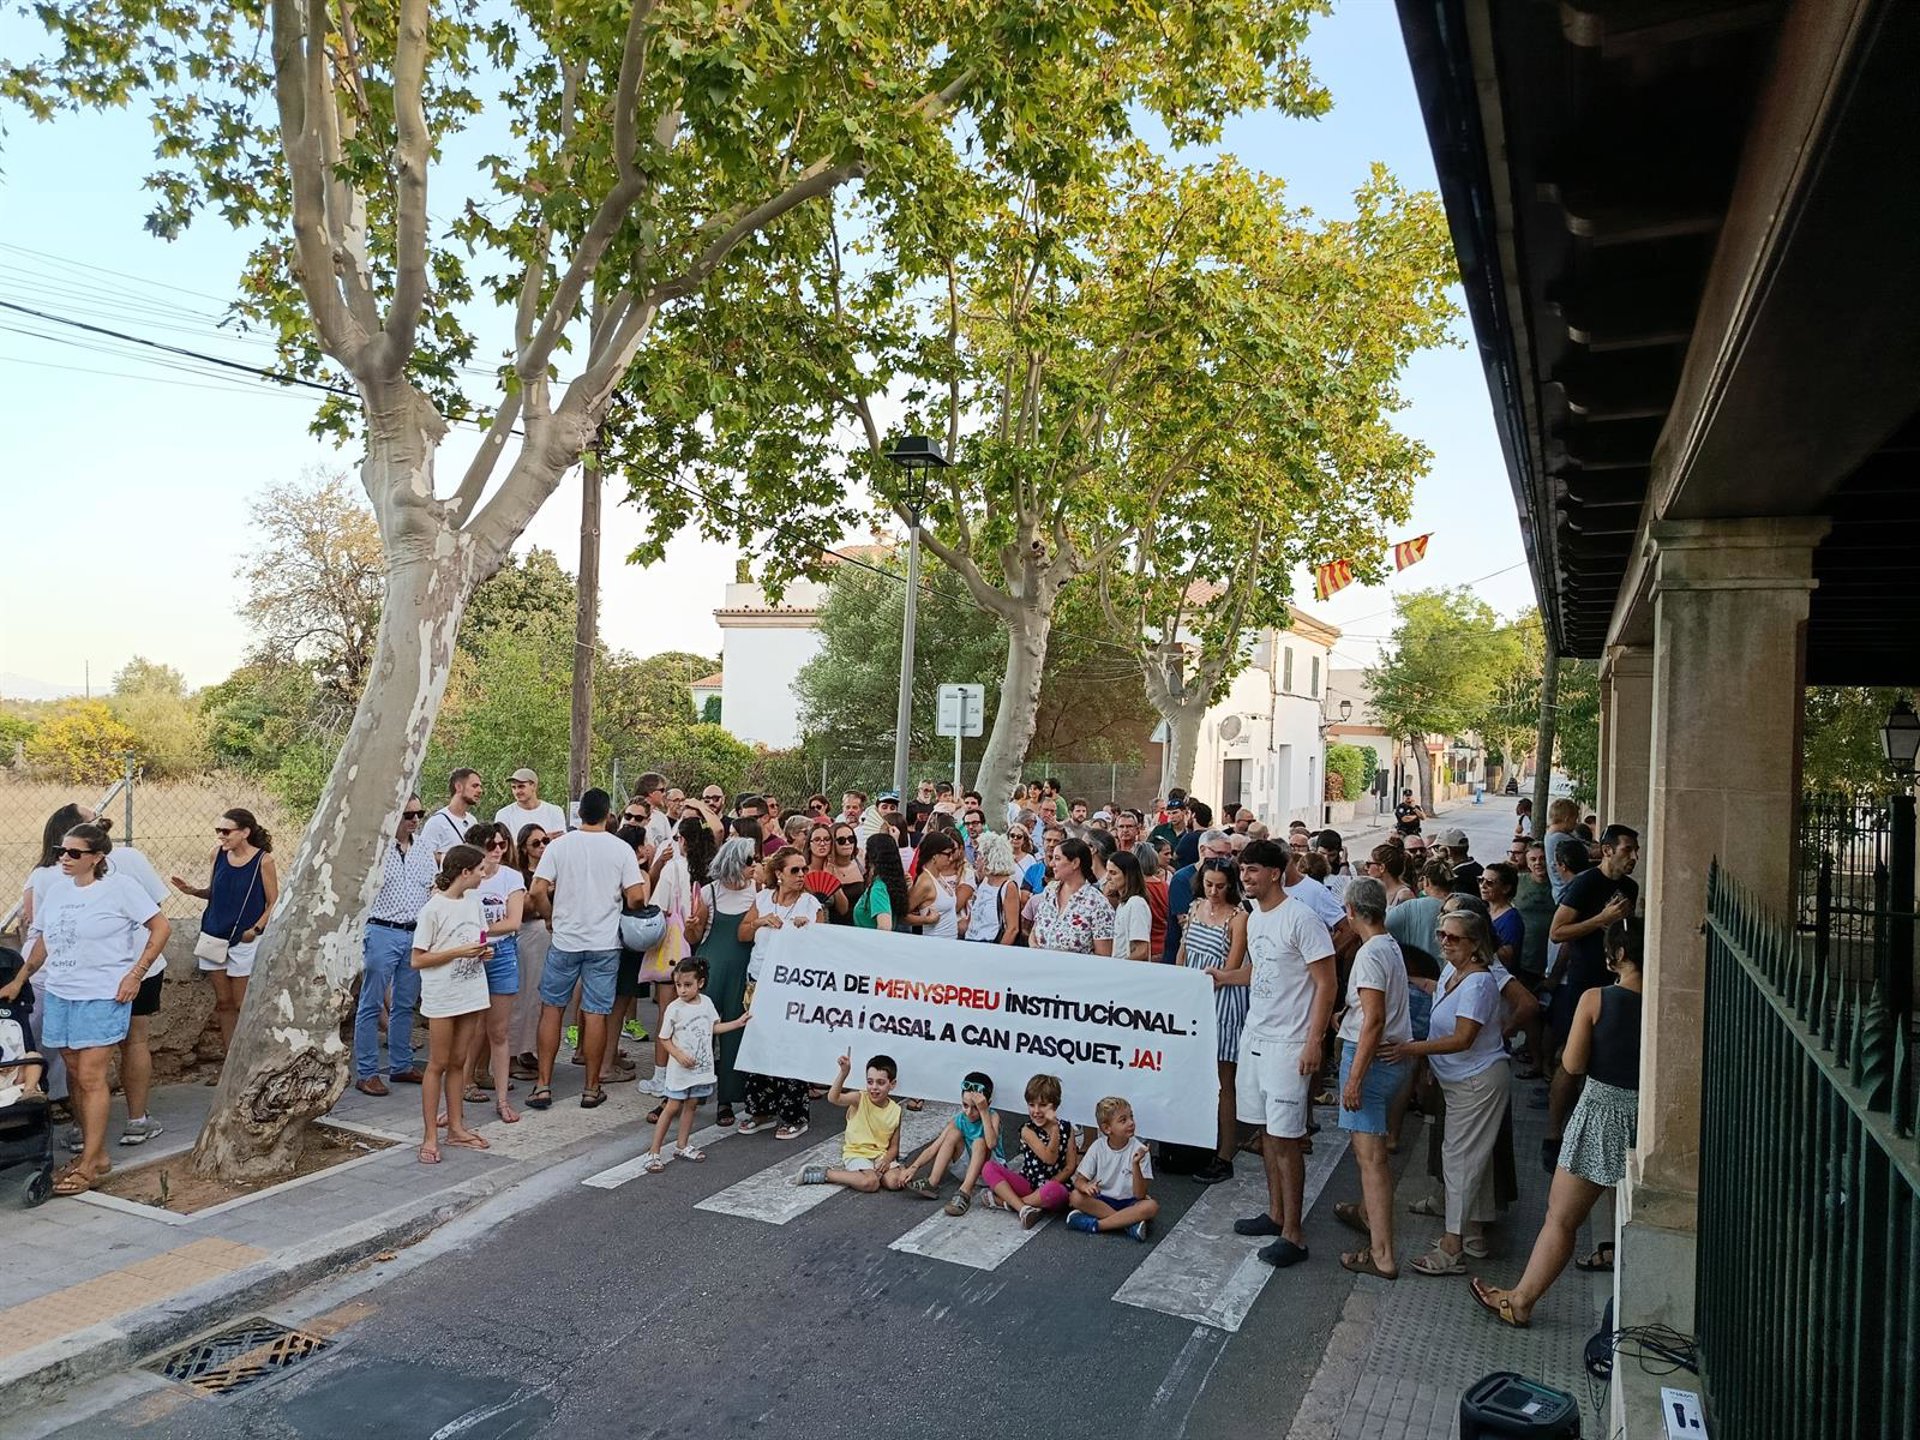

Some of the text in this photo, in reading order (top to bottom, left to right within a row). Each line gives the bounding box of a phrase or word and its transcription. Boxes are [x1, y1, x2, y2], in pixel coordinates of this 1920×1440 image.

[773, 965, 837, 992] BASTA
[844, 974, 871, 994] DE
[874, 977, 1000, 1011] MENYSPREU
[785, 1001, 854, 1033] PLAÇA
[869, 1012, 936, 1041] CASAL
[939, 1023, 957, 1043] A
[961, 1024, 1010, 1050] CAN
[1128, 1048, 1163, 1072] JA!
